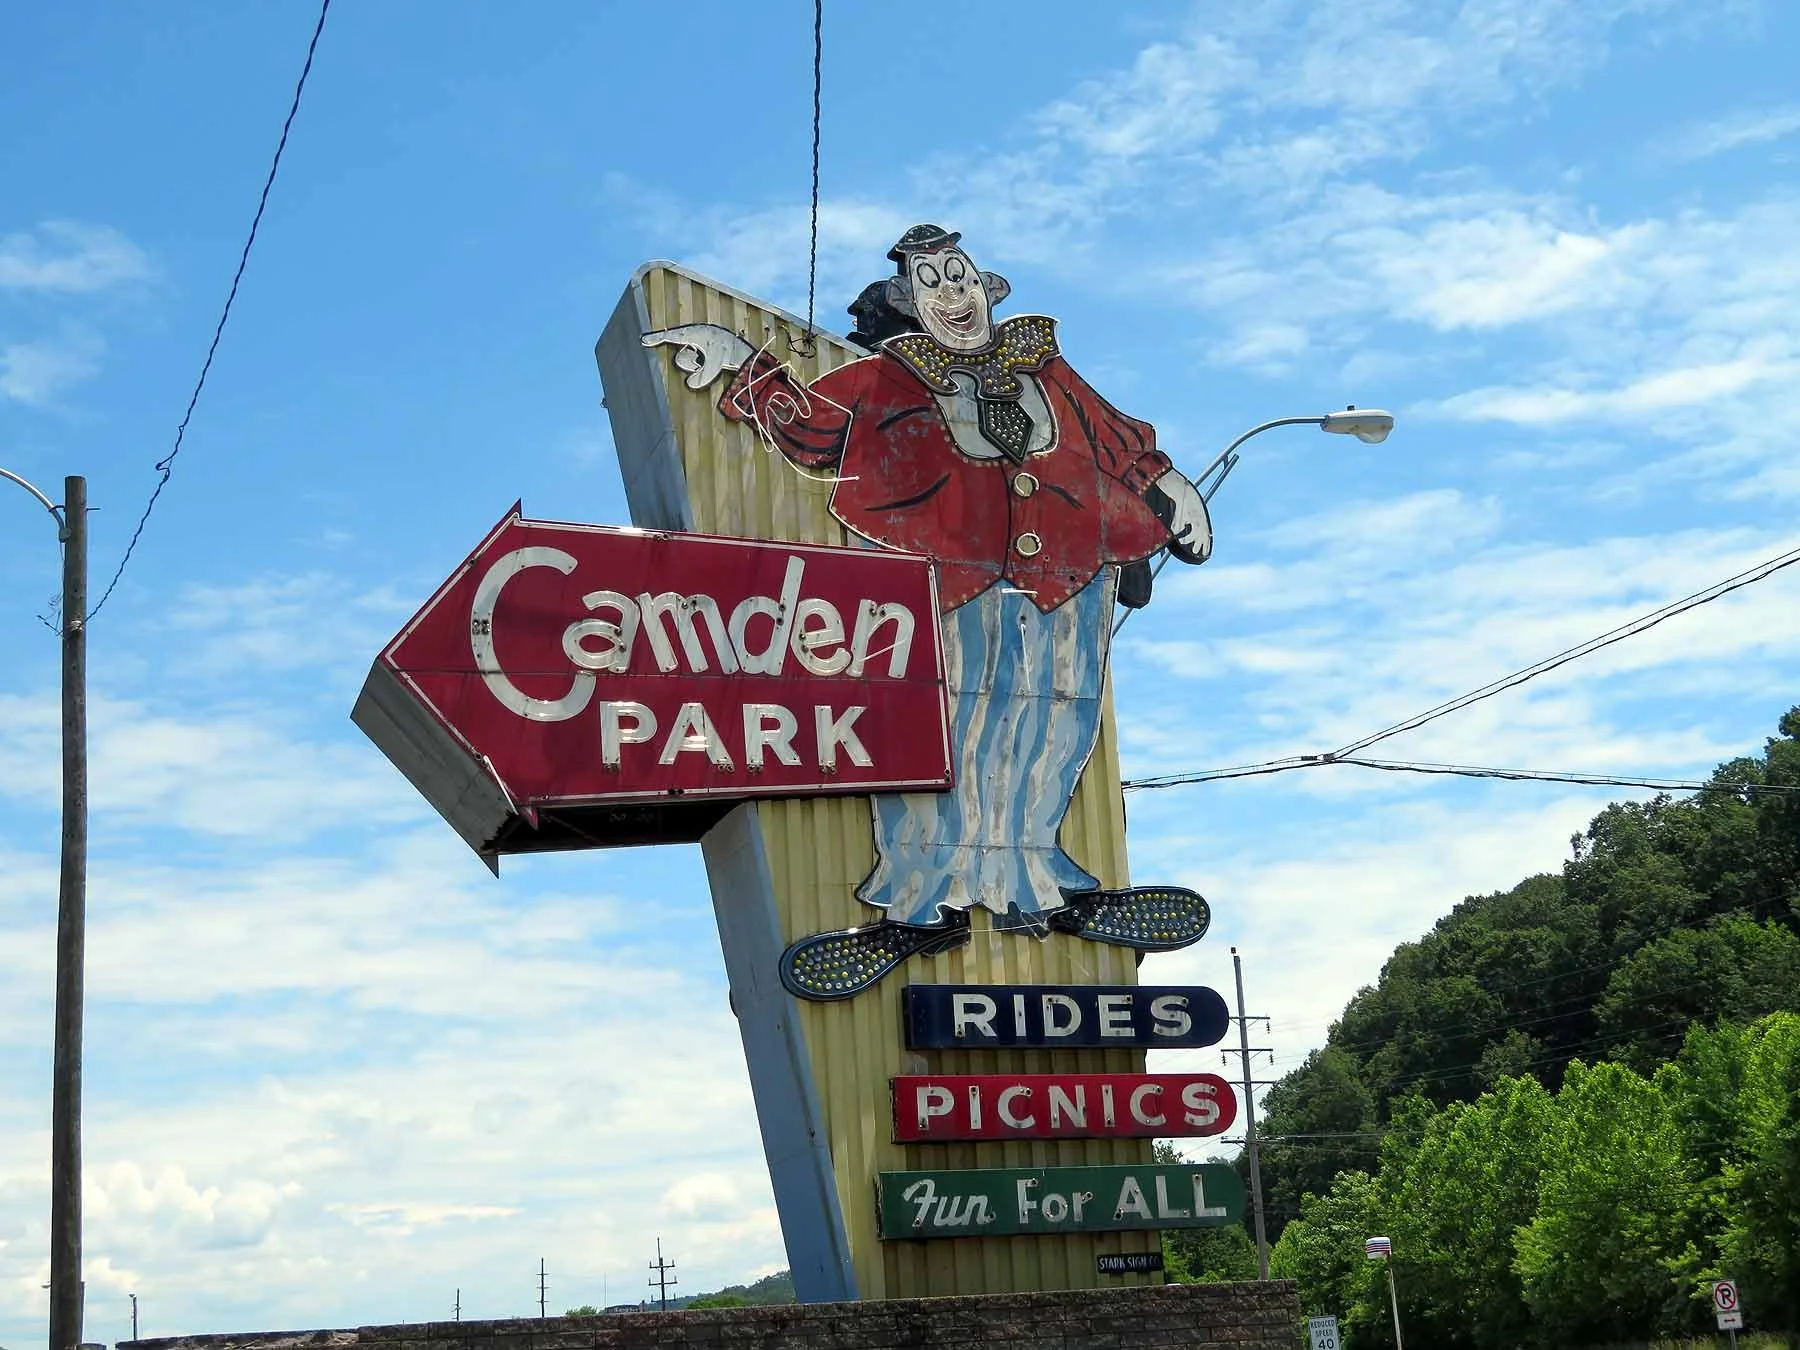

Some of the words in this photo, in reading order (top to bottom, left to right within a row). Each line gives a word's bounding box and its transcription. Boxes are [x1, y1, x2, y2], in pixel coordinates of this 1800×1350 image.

[471, 546, 915, 722] Camden
[599, 702, 874, 771] PARK
[952, 993, 1192, 1038] RIDES
[915, 1083, 1221, 1131] PICNICS
[903, 1178, 996, 1227] Fun
[1017, 1178, 1093, 1224] For
[1113, 1174, 1227, 1221] ALL
[1099, 1256, 1126, 1270] STARK
[1127, 1256, 1146, 1269] SIGN
[1310, 1320, 1335, 1328] REDUCED
[1318, 1338, 1334, 1349] 40
